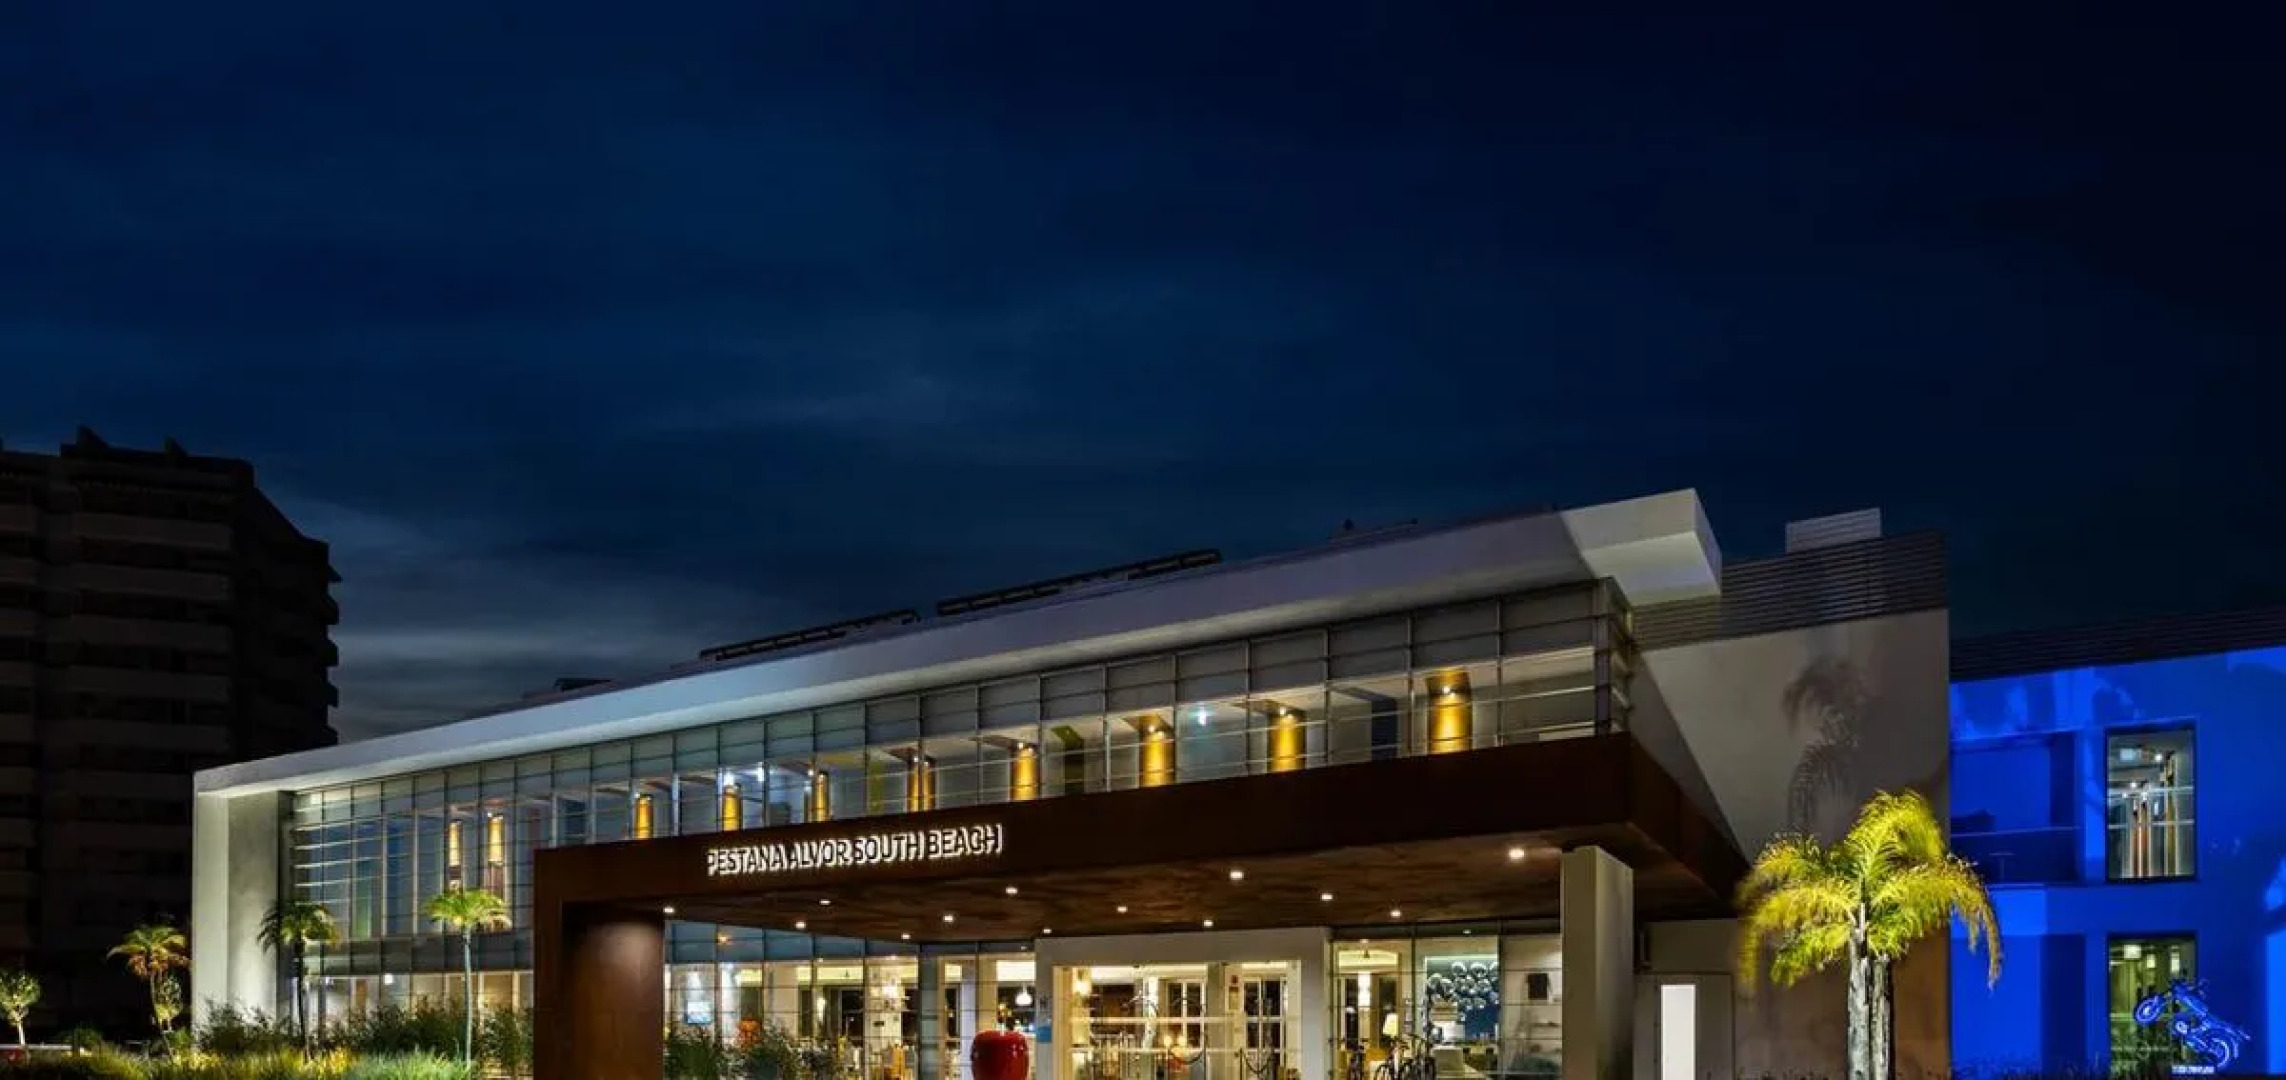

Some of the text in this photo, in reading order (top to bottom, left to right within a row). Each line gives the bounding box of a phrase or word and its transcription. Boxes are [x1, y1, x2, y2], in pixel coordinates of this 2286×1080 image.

[707, 824, 1002, 876] PESTANA ALVOR SOUTH BEACH
